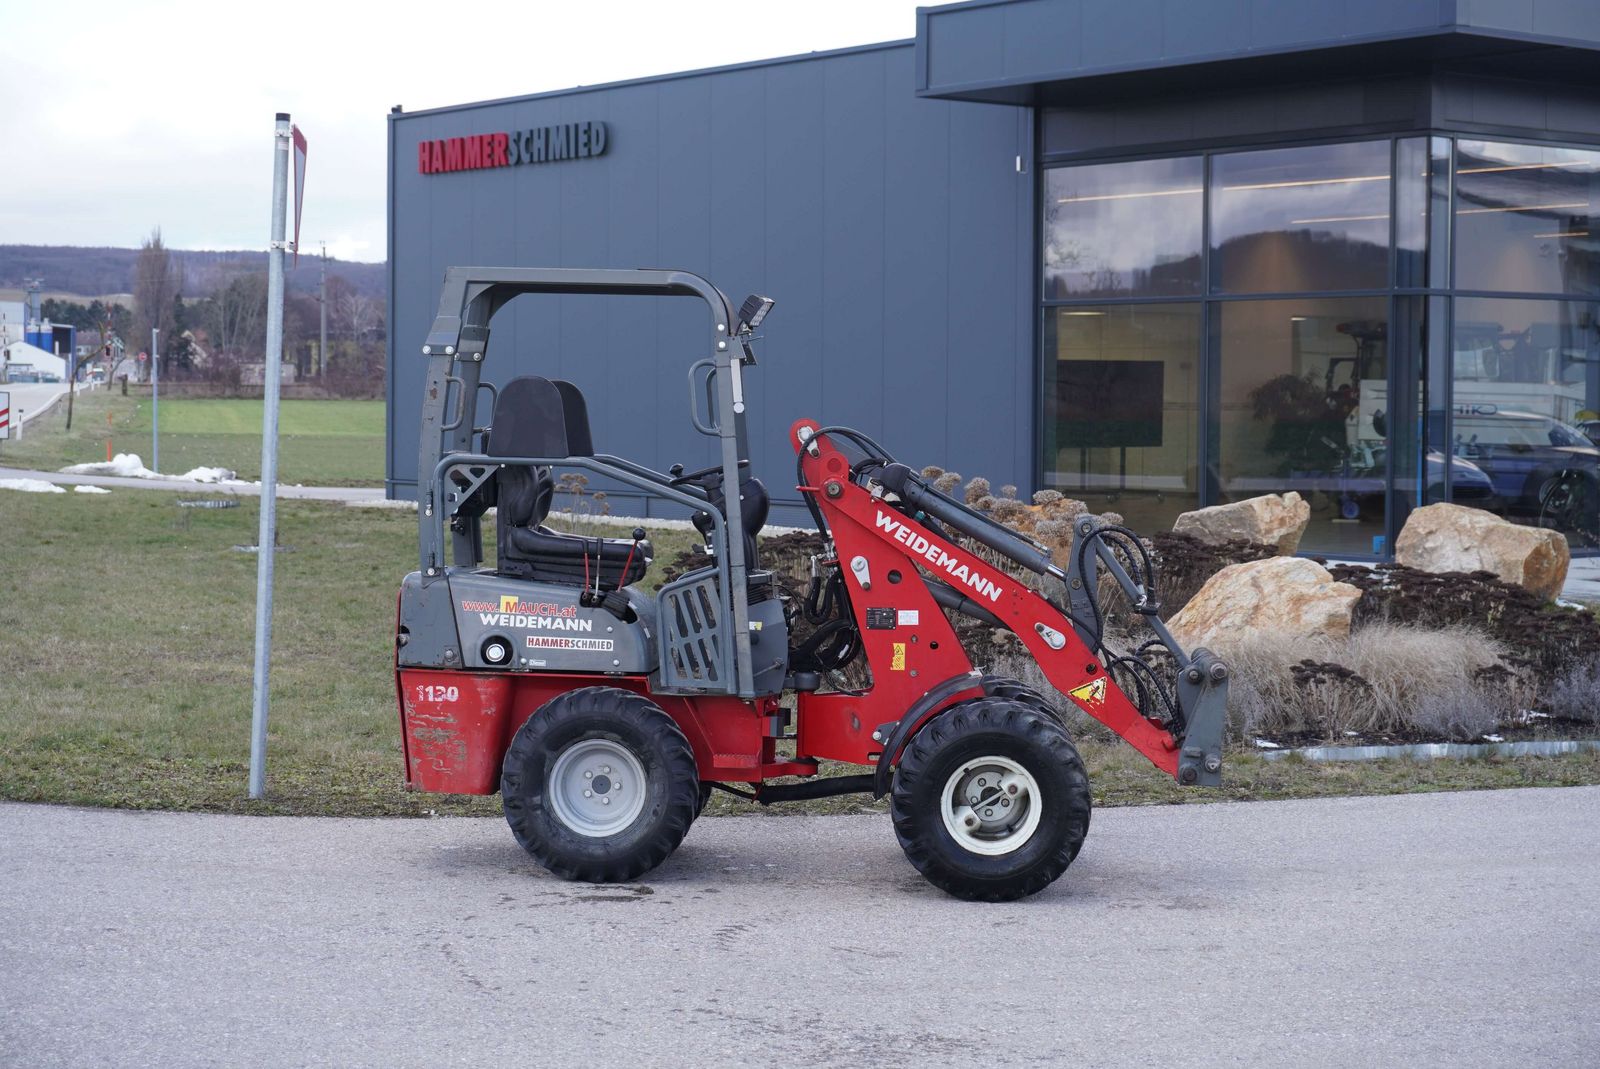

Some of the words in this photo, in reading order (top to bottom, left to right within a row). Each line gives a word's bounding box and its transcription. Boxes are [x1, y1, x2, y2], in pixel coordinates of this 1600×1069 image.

[418, 121, 609, 174] HAMMERSCHMIED
[875, 509, 1003, 602] WEIDEMANN
[480, 613, 592, 632] WEIDEMANN
[528, 637, 612, 650] HAMMERSCHMIED
